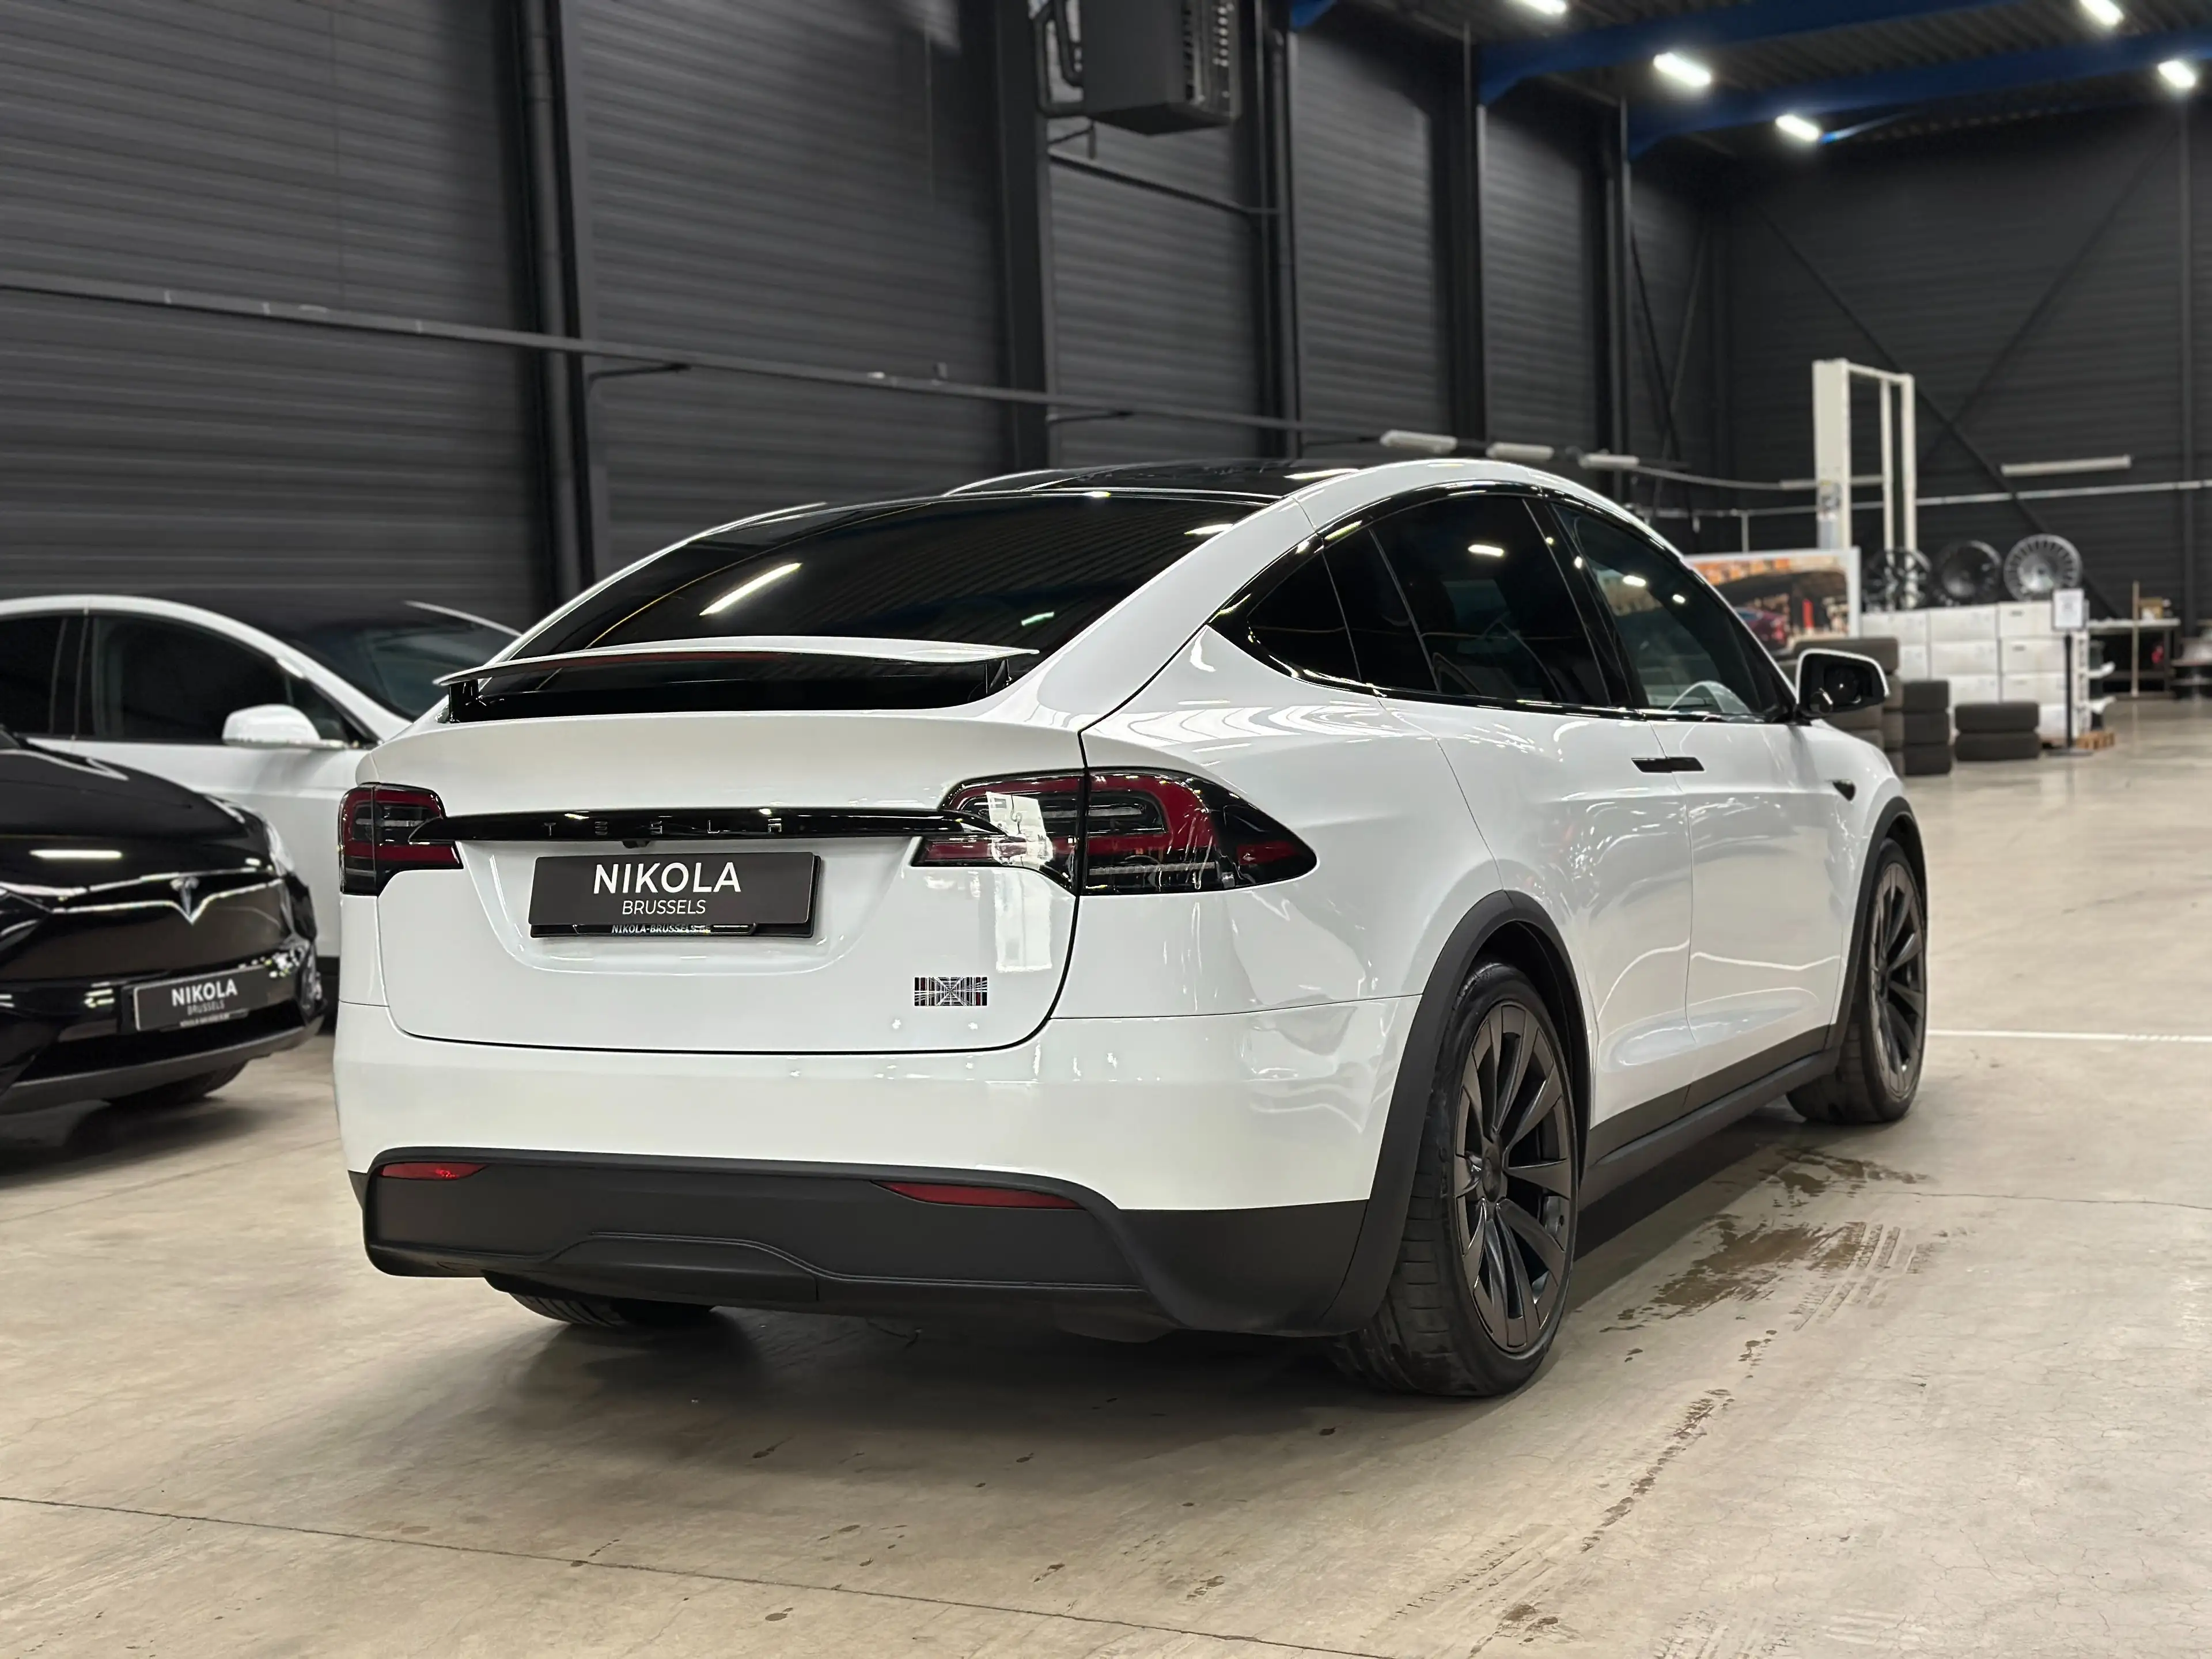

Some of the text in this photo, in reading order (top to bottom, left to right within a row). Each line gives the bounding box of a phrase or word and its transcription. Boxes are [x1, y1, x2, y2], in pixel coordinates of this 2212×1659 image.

[544, 818, 782, 836] TESLA
[593, 862, 741, 894] NIKOLA
[622, 900, 706, 915] BRUSSELS
[172, 978, 238, 1006] NIKOLA
